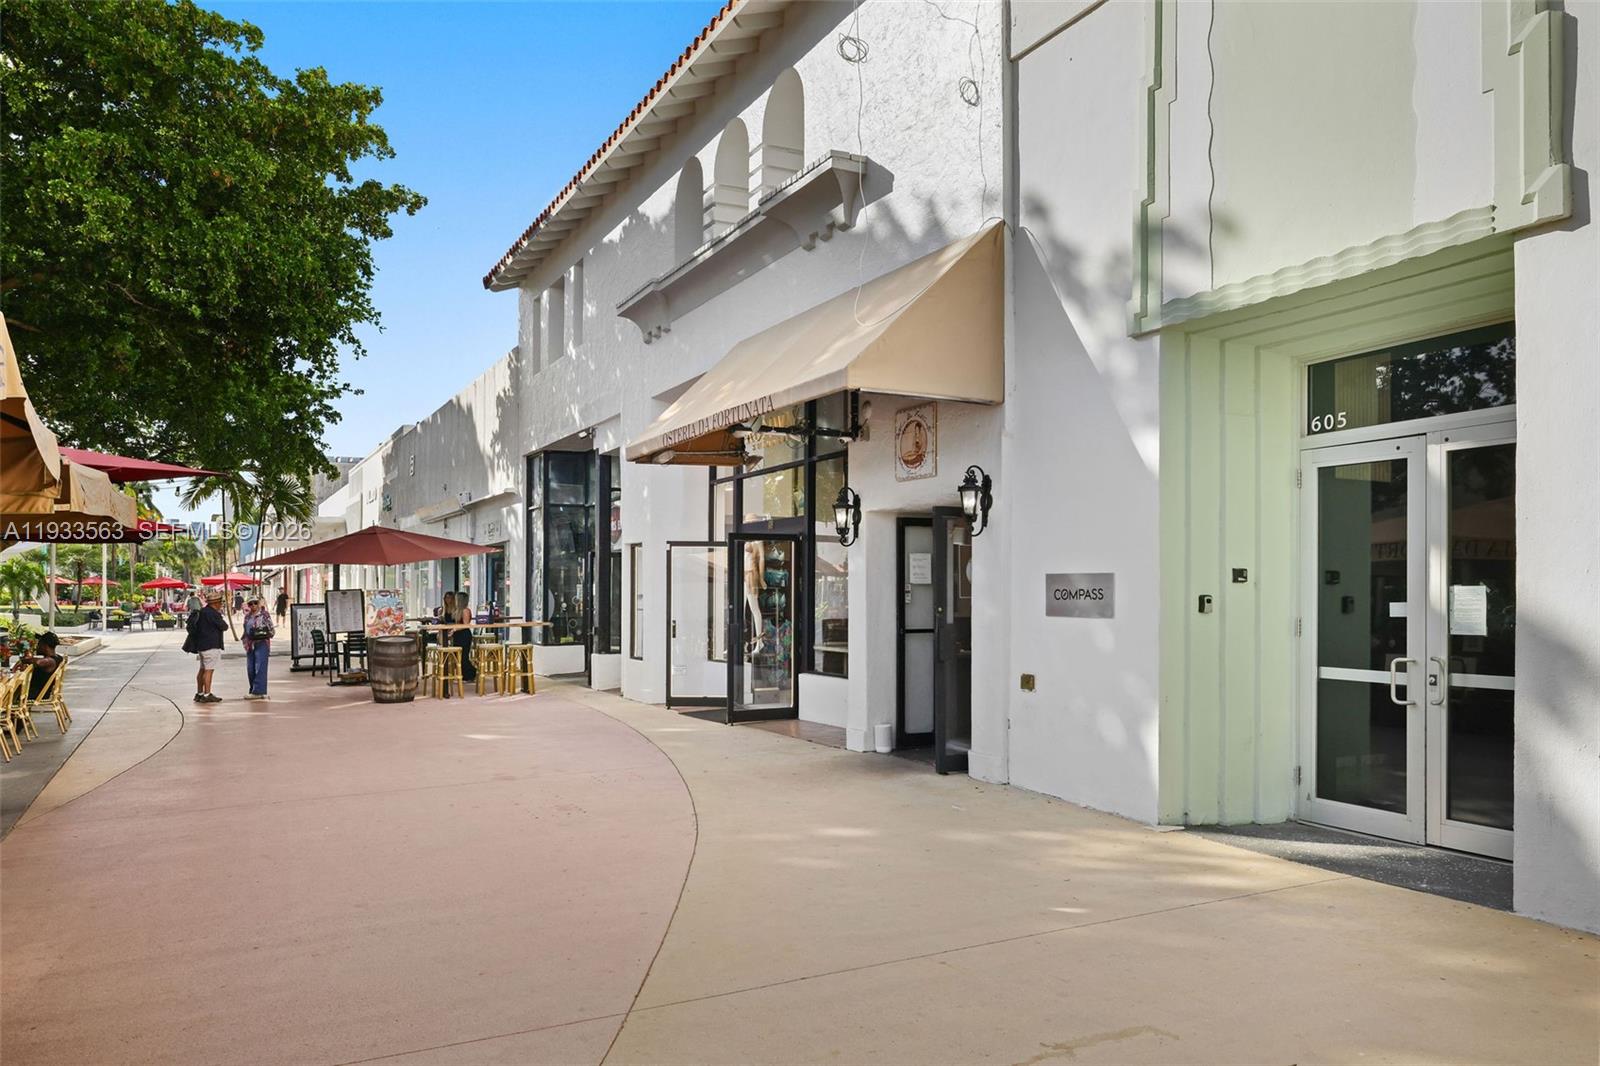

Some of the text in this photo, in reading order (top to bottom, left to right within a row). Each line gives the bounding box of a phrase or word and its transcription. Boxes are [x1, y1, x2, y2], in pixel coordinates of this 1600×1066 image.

[662, 395, 775, 447] OSTERIA DA FORTUNATA
[1311, 411, 1347, 432] 605
[1053, 587, 1105, 601] COMPASS
